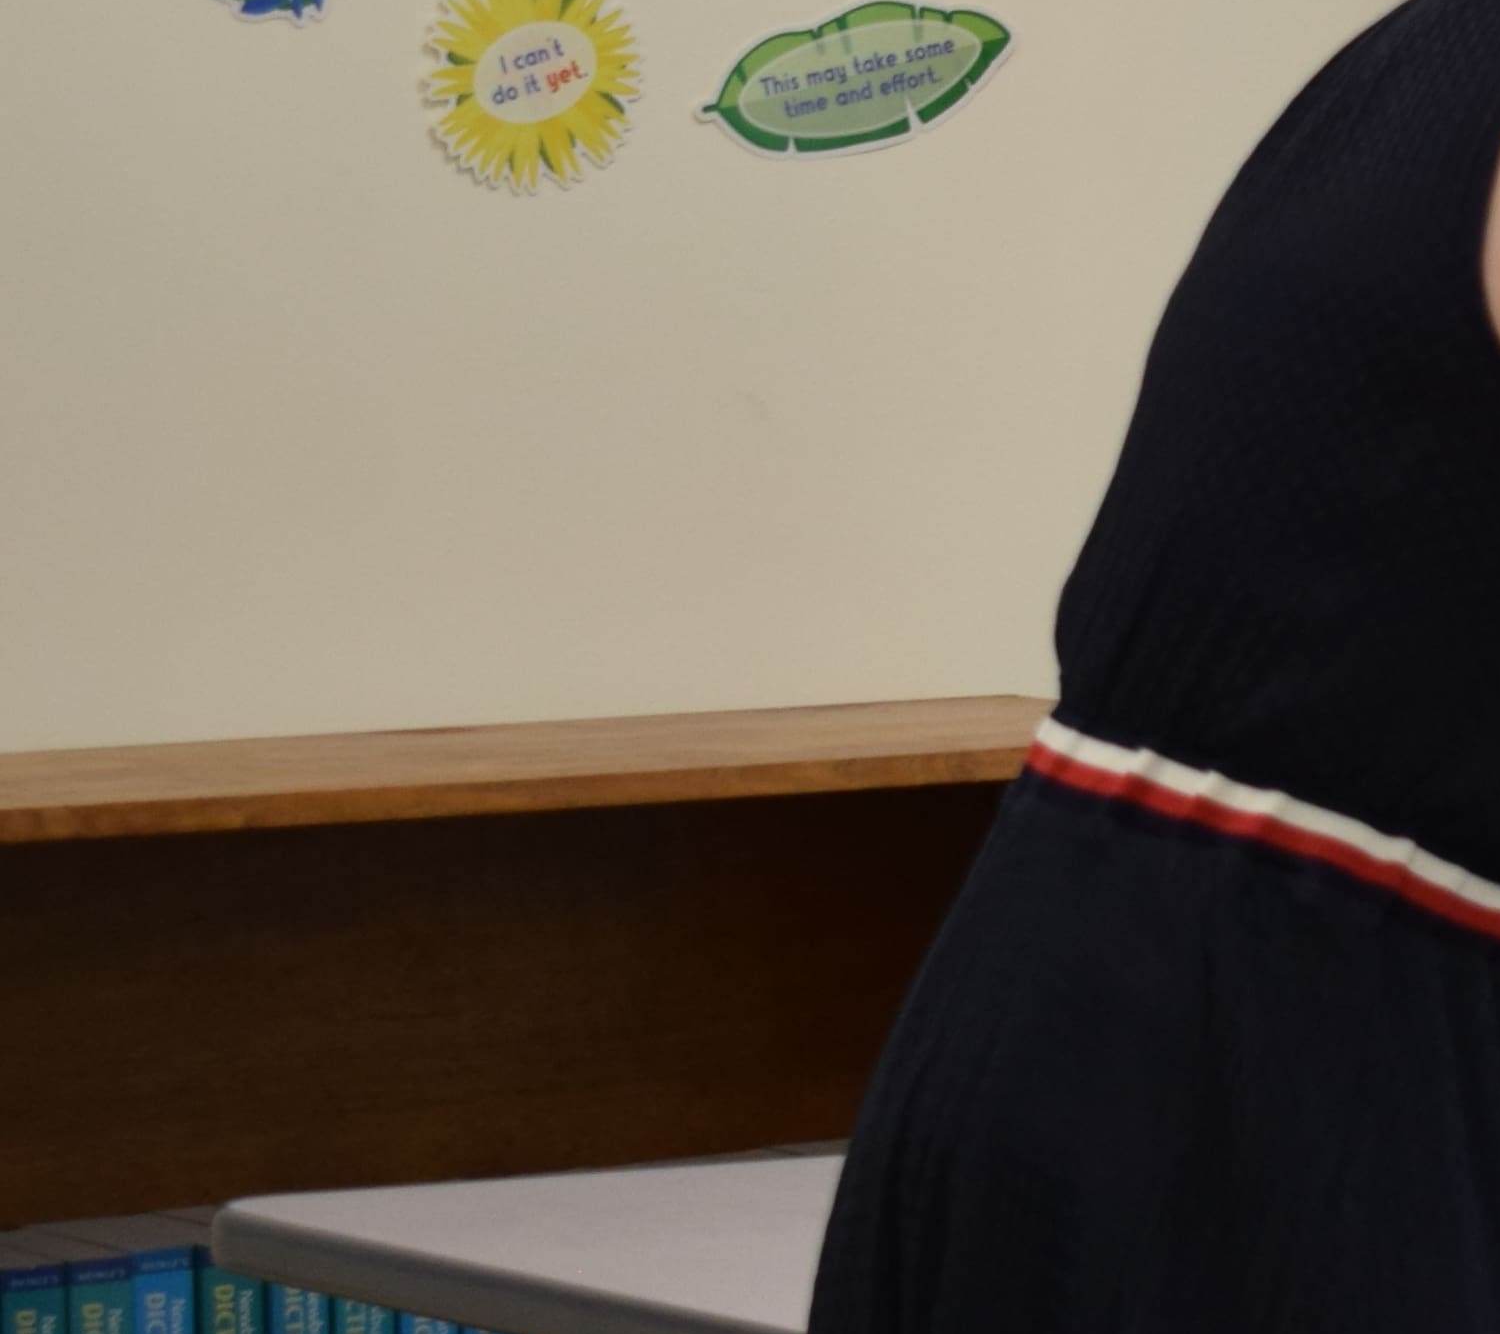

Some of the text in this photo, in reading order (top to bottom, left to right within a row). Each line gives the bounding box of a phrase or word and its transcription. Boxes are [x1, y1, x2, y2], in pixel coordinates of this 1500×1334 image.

[500, 37, 564, 75] I can't
[760, 39, 955, 97] This may take some
[492, 60, 588, 105] do it yet.
[784, 67, 941, 118] time and effort.
